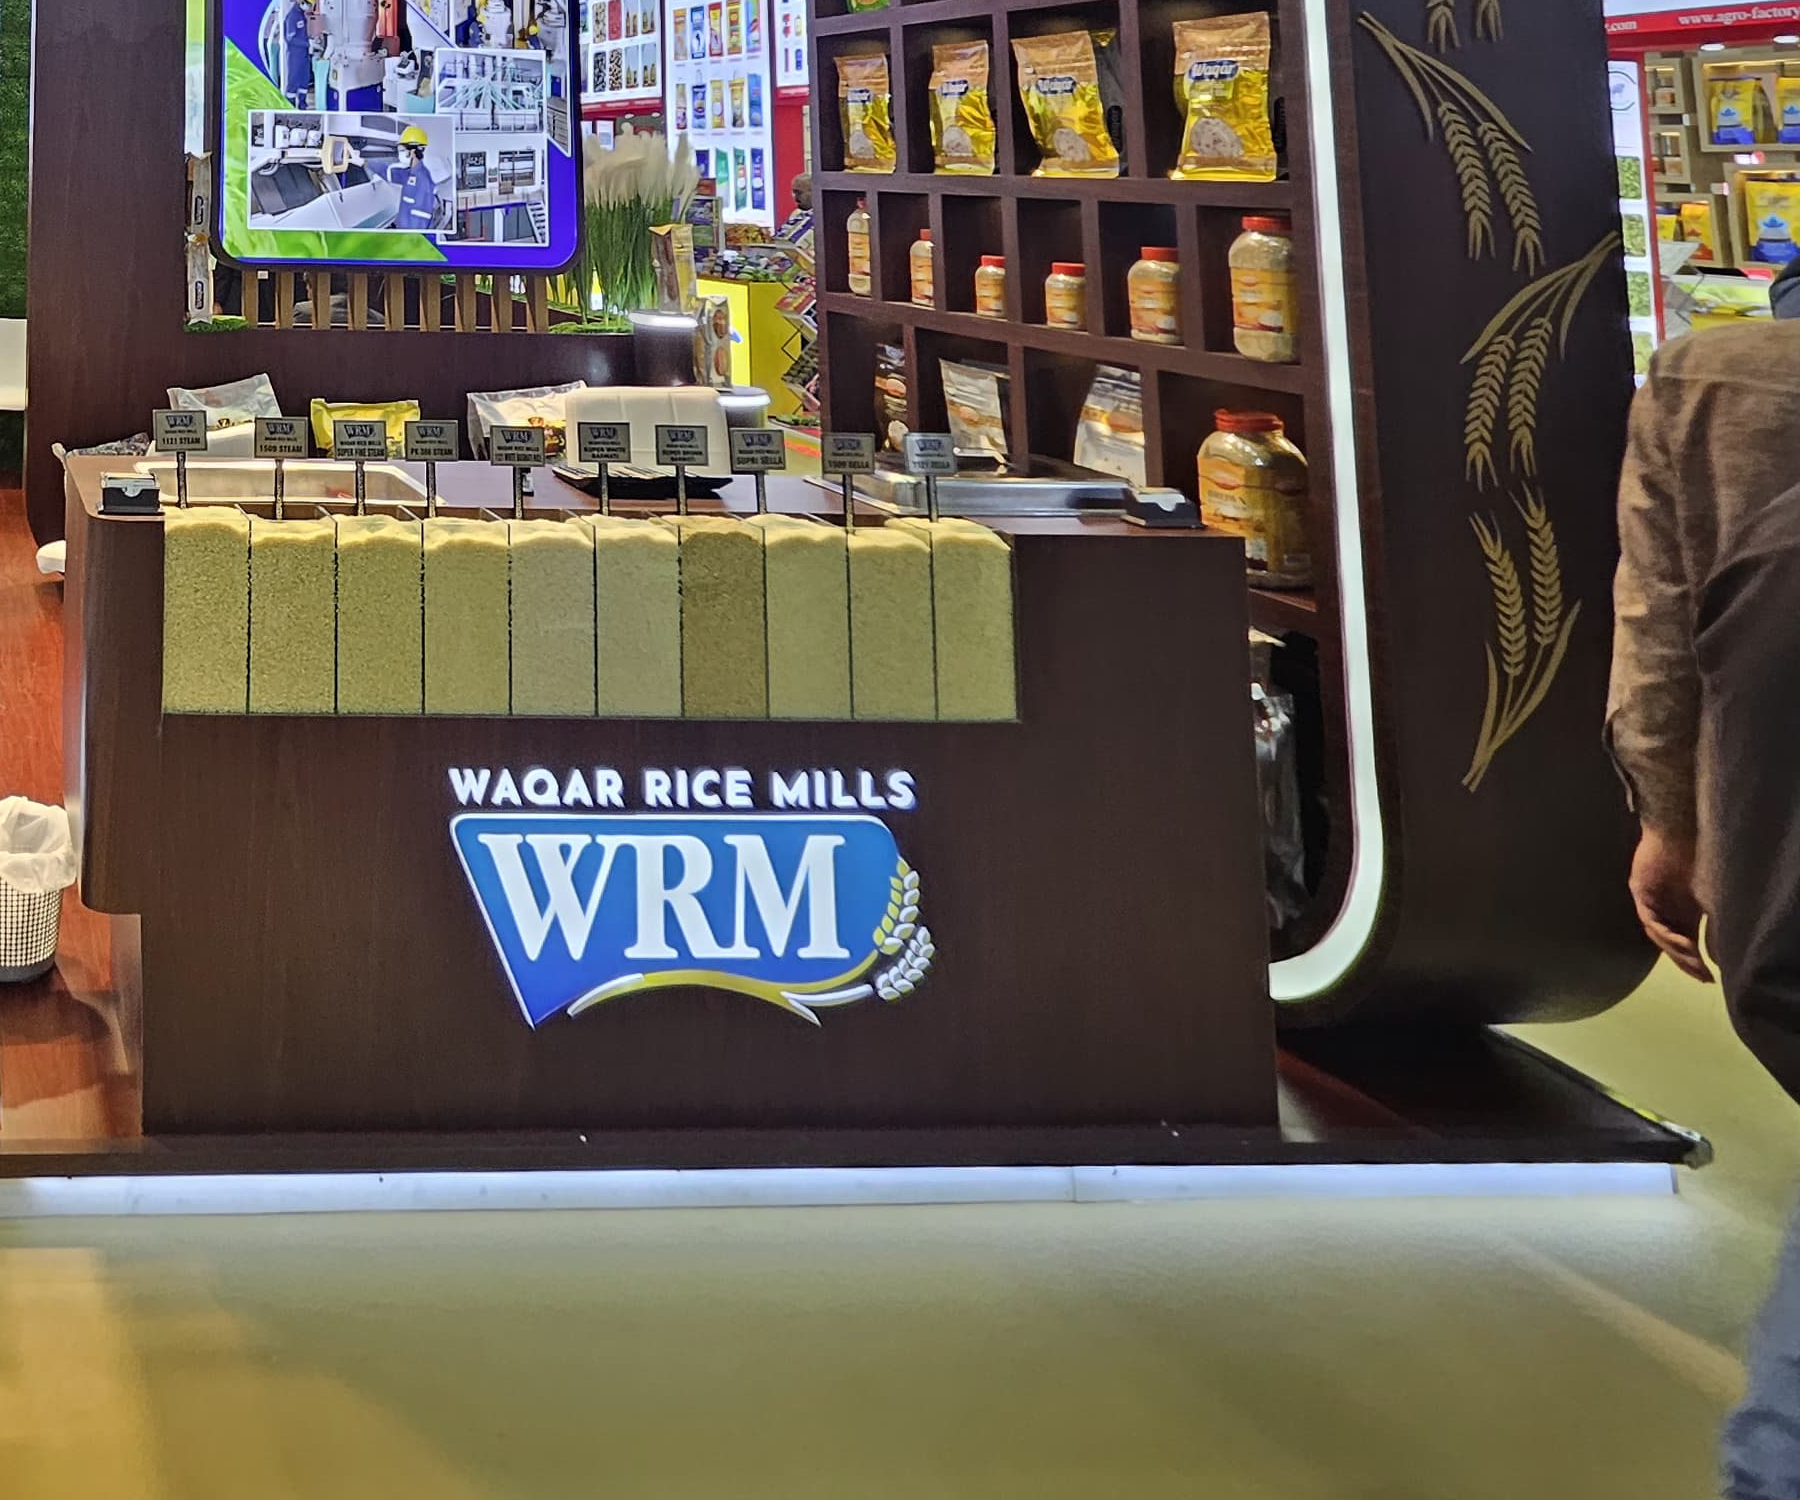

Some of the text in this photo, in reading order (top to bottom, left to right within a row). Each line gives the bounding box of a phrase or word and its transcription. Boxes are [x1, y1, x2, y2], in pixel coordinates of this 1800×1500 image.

[179, 437, 200, 445] STEAM
[279, 445, 302, 453] STEAM
[761, 457, 783, 465] SELLA
[448, 767, 918, 810] WAQAR RICE MILLS
[478, 834, 850, 961] WRM
